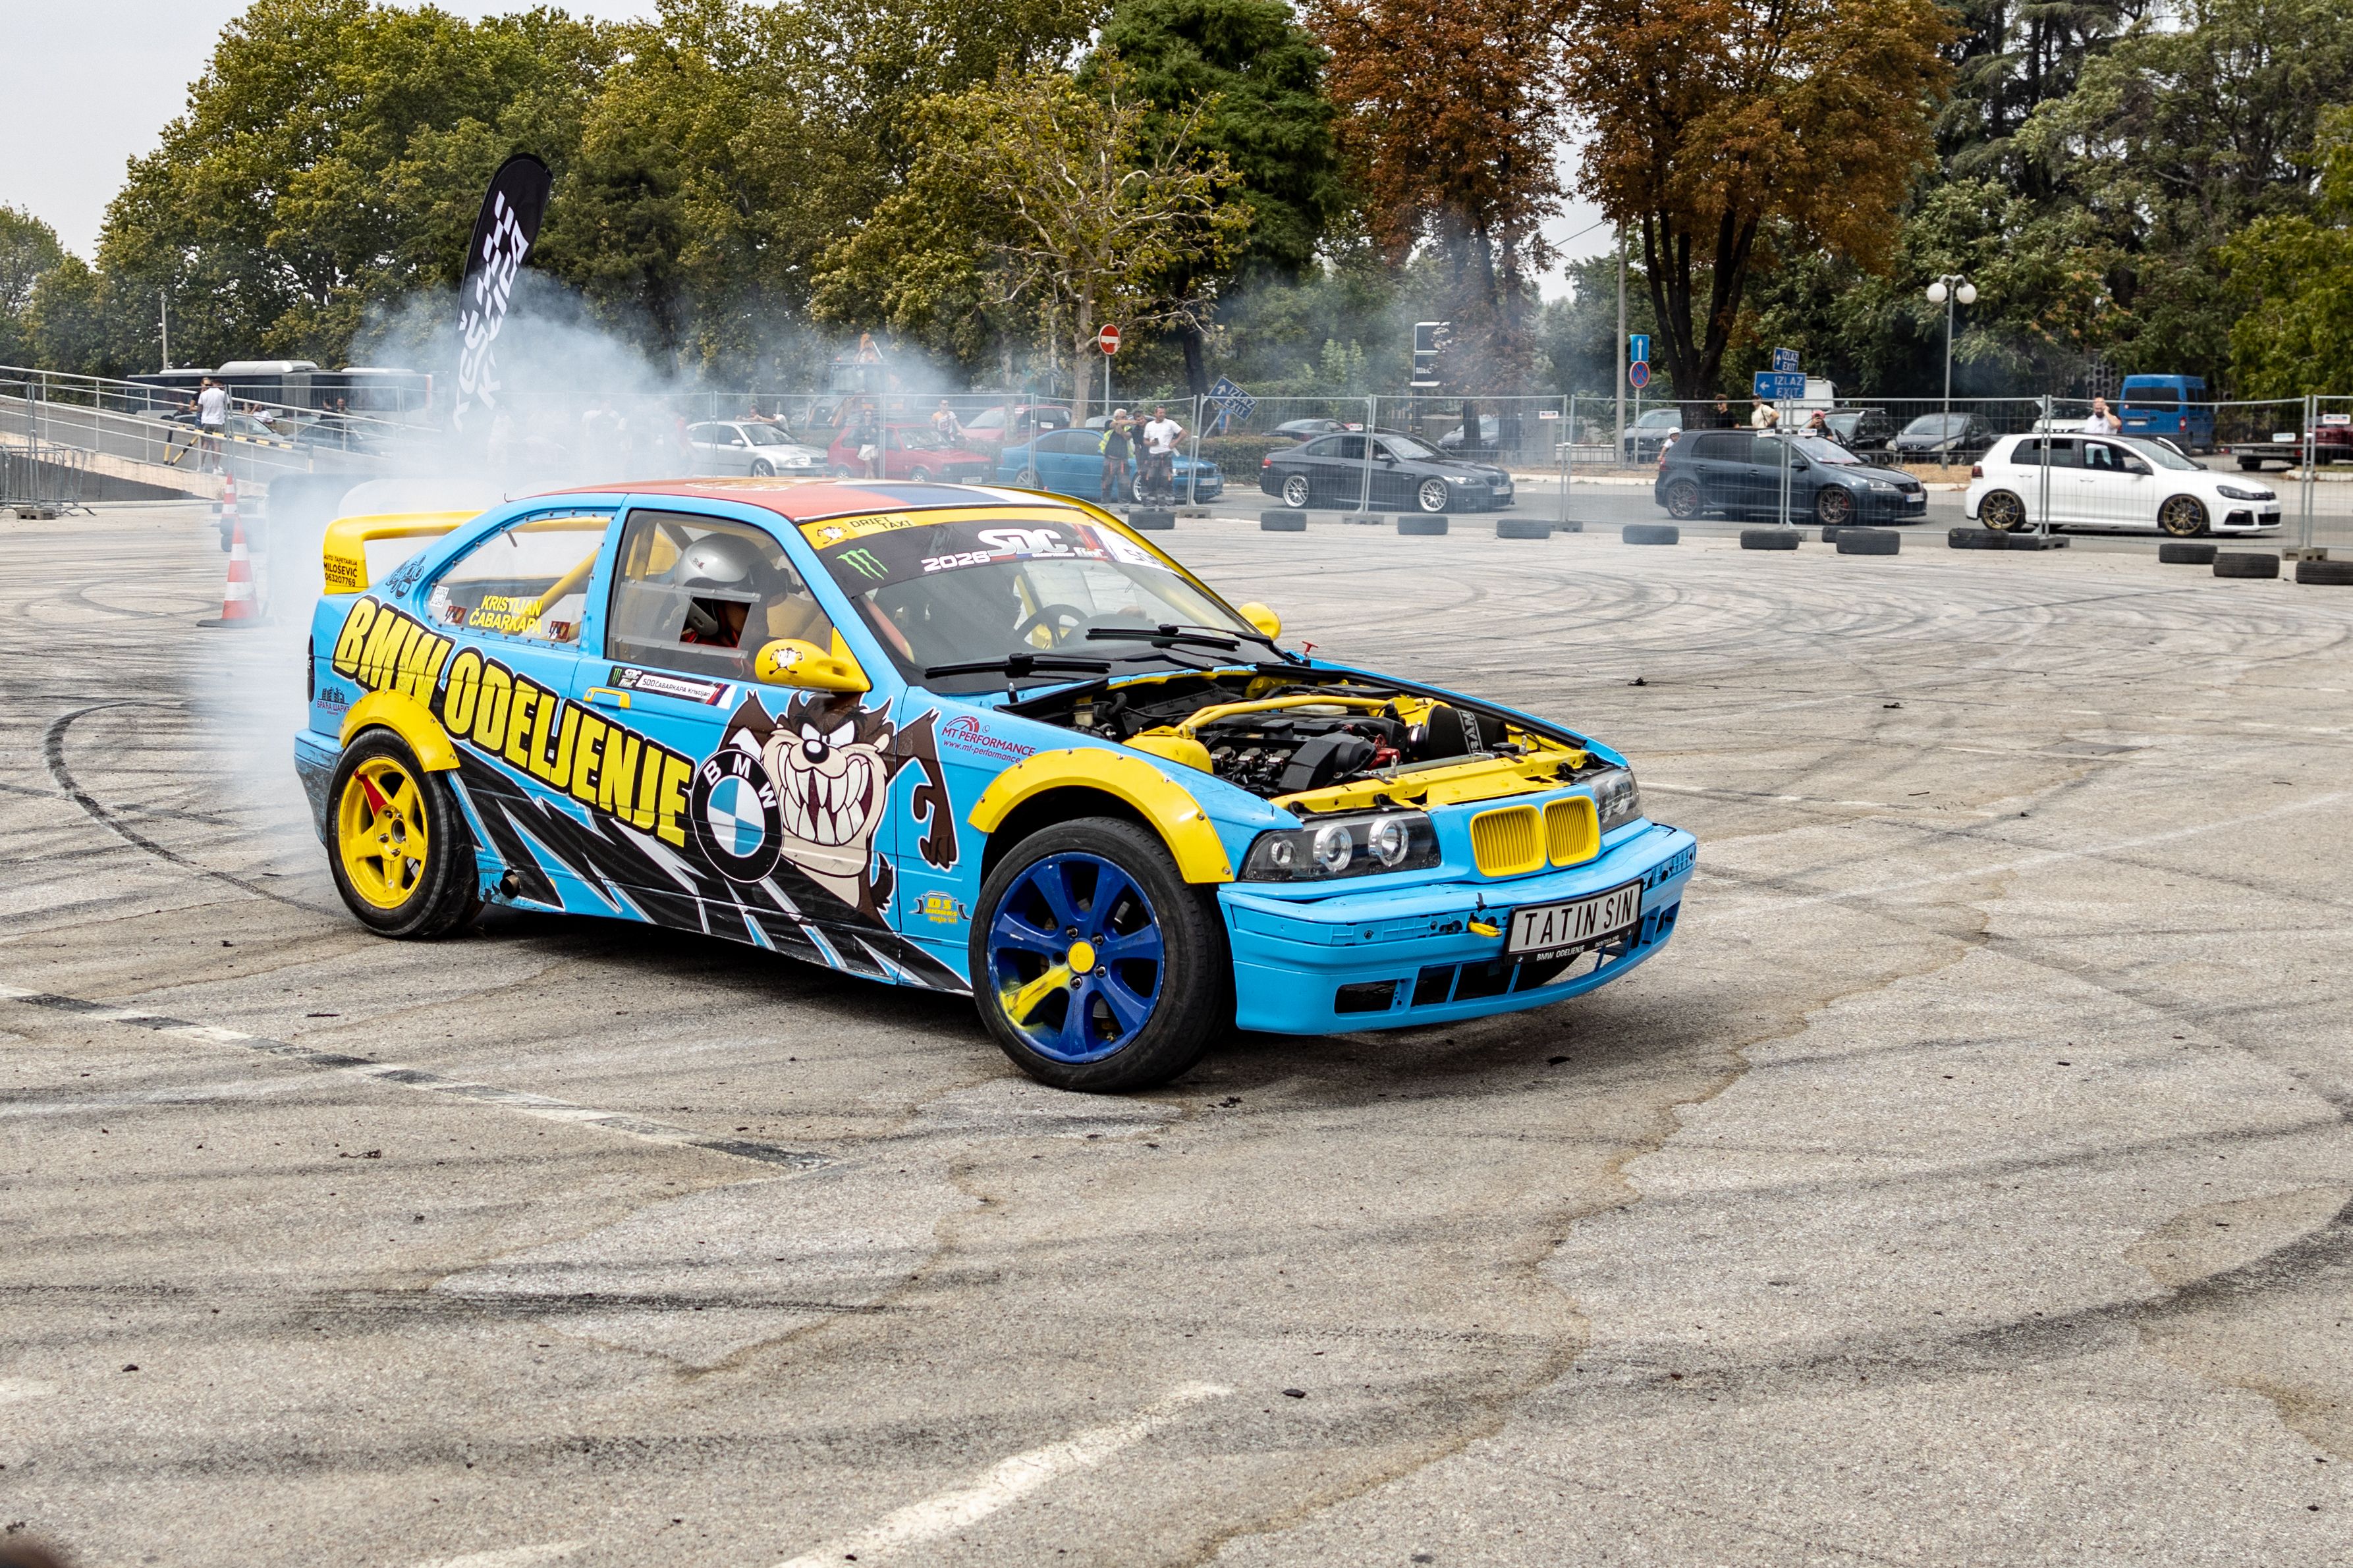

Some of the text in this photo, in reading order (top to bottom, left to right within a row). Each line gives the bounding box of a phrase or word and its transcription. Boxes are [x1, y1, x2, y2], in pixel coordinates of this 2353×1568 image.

[1782, 351, 1799, 362] IZLAZ
[1783, 362, 1796, 371] EXIT
[1775, 375, 1803, 386] IZLAZ
[1228, 386, 1256, 409] IZLAZ
[1777, 387, 1800, 396] EXIT
[1225, 398, 1247, 416] EXIT
[850, 516, 891, 527] DRIFT
[882, 520, 913, 529] TAXI
[921, 551, 991, 572] 2026
[978, 529, 1068, 556] SDC
[323, 562, 357, 578] MILOŠEVIĆ
[325, 572, 356, 587] 063207769
[481, 595, 543, 616] KRISTIJAN
[469, 607, 542, 634] ČABARKAPA
[642, 678, 655, 687] 500
[688, 688, 710, 697] Kristijan
[333, 597, 696, 849] BMW ODELJENJE
[941, 727, 1036, 757] MT PERFORMANCE
[703, 753, 777, 809] BMW
[1524, 889, 1634, 946] TATIN SIN
[1536, 952, 1554, 961] BMW
[1556, 945, 1585, 958] ODELJENJE
